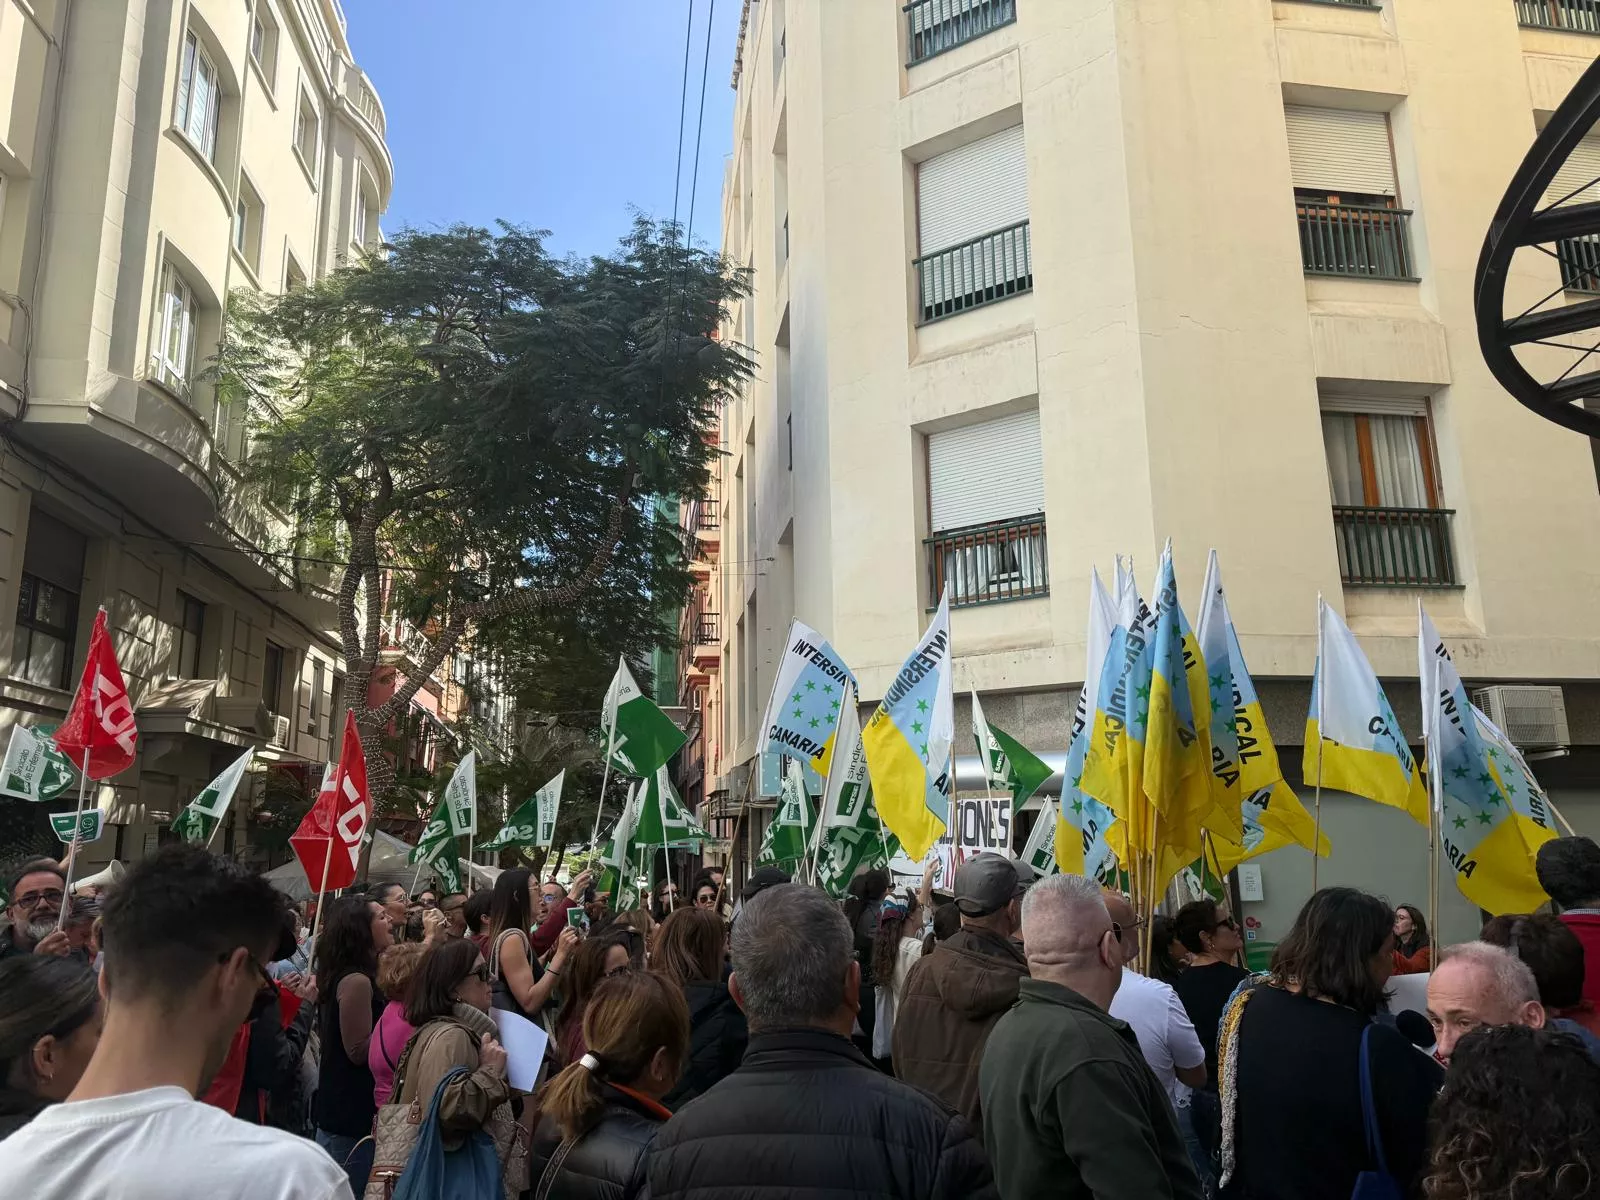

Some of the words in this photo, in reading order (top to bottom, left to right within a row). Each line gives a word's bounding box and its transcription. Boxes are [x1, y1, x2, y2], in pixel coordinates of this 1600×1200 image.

[768, 724, 826, 760] CANARIA
[856, 766, 865, 781] de
[845, 784, 860, 815] SATSE
